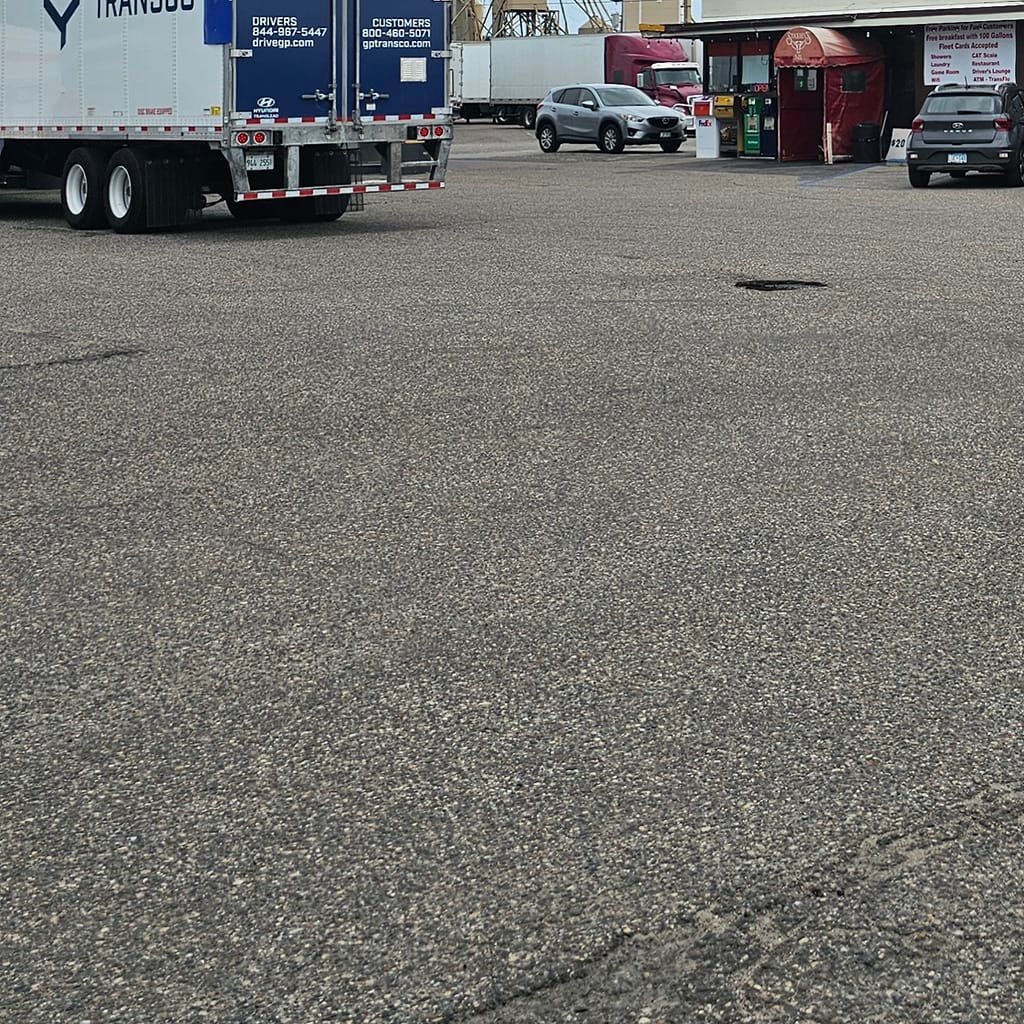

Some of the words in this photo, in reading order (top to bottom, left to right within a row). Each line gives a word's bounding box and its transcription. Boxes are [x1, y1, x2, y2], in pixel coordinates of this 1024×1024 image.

[252, 17, 297, 26] DRIVERS
[372, 18, 431, 28] CUSTOMERS
[983, 22, 1013, 30] Customers
[252, 27, 327, 36] 844-967-5447
[362, 28, 431, 38] 800-460-5071
[939, 33, 965, 41] breakfast
[252, 37, 314, 49] drivegp.com
[362, 39, 431, 50] gptransco.com
[939, 42, 954, 50] Fleet
[971, 41, 998, 50] Accepted
[890, 139, 906, 147] $20
